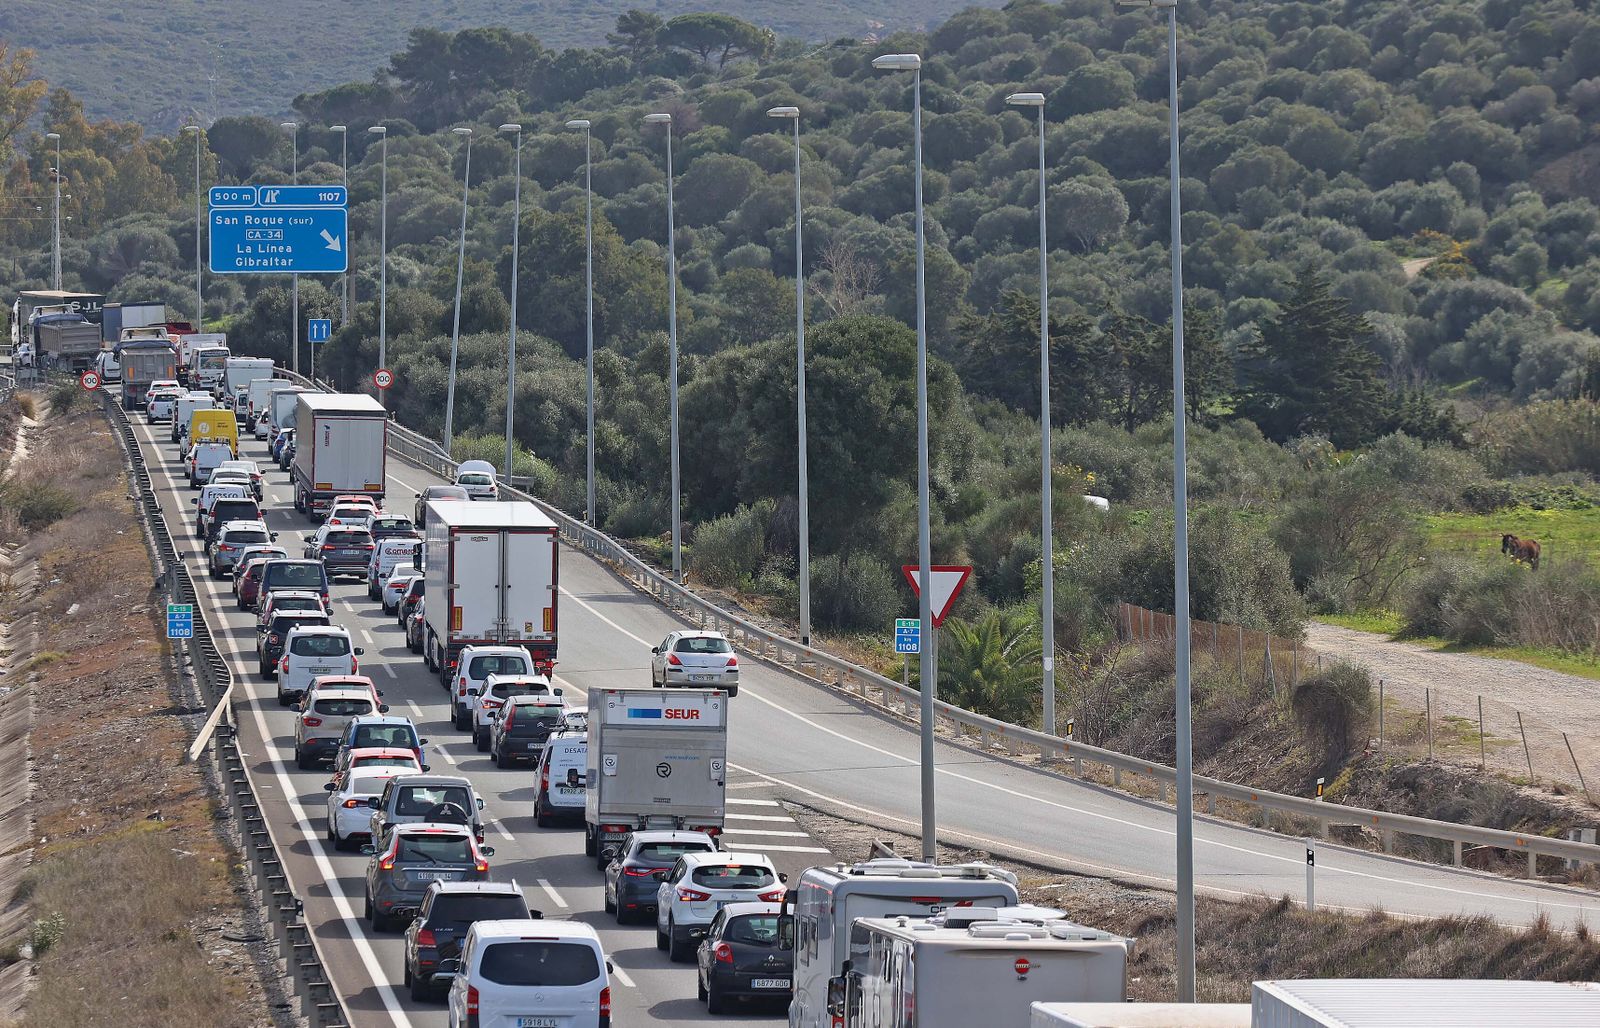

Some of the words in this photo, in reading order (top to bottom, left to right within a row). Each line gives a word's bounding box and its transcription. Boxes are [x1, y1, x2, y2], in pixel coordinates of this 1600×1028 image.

[215, 193, 238, 201] 500
[318, 193, 340, 201] 1107
[215, 215, 238, 225] San
[244, 215, 284, 227] Roque
[288, 217, 314, 226] (sur)
[247, 231, 282, 239] CA-34
[237, 244, 252, 253] La
[258, 243, 293, 253] Línea
[235, 257, 294, 267] Gibraltar
[70, 301, 103, 311] SJL
[376, 375, 390, 383] 100
[664, 708, 700, 720] SEUR
[522, 1018, 542, 1027] 5918
